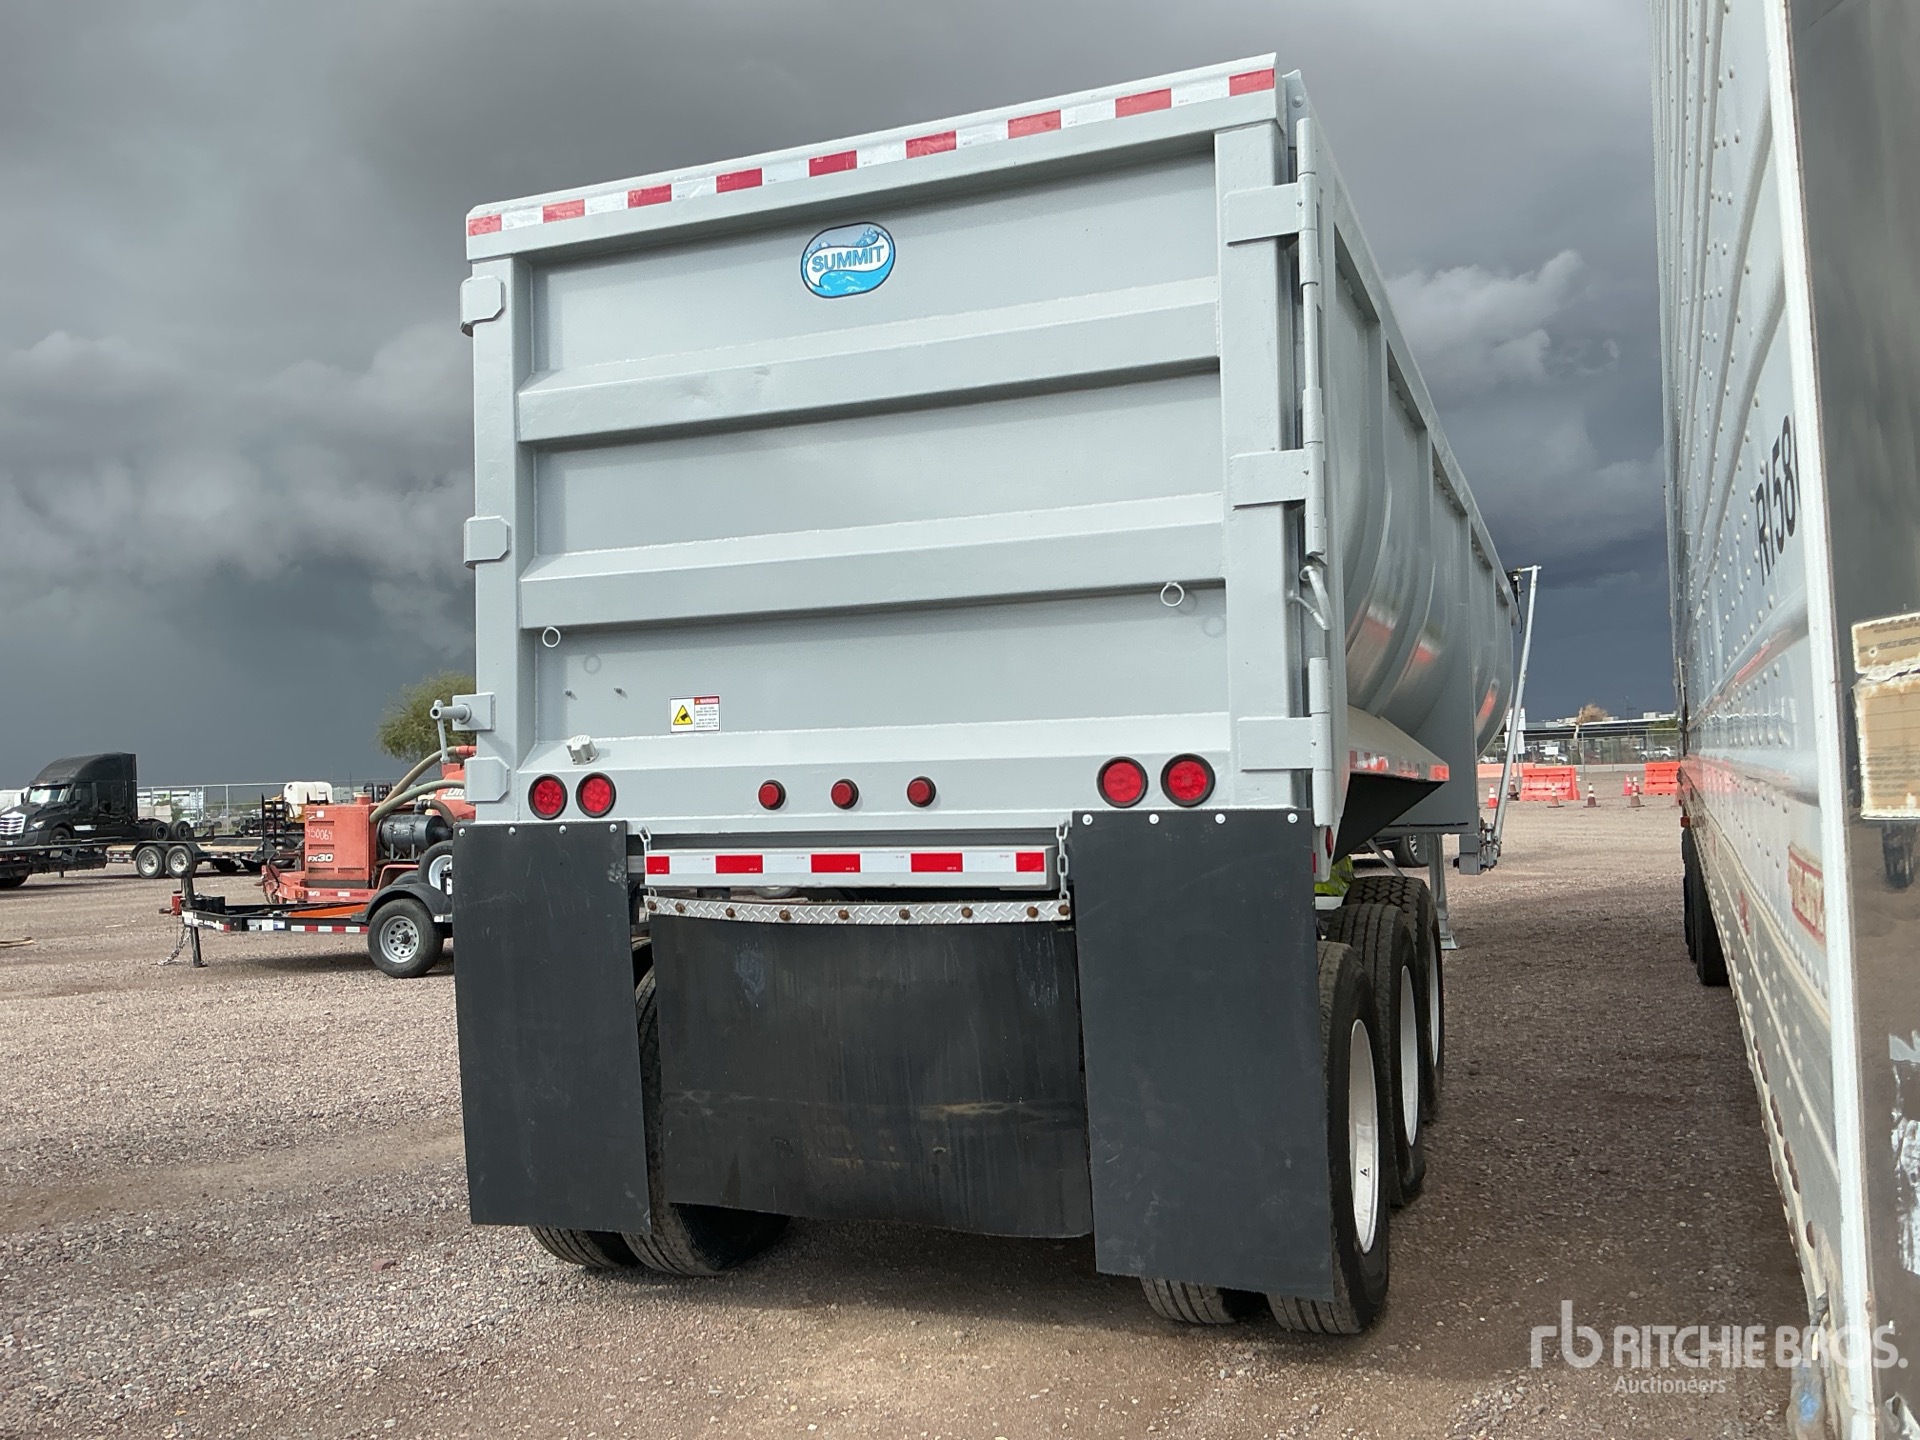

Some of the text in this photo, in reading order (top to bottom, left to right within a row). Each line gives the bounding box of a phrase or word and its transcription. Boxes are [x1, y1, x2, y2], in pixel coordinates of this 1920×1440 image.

[812, 245, 884, 272] SUMMIT
[1755, 415, 1801, 586] R158
[307, 853, 333, 863] FX30
